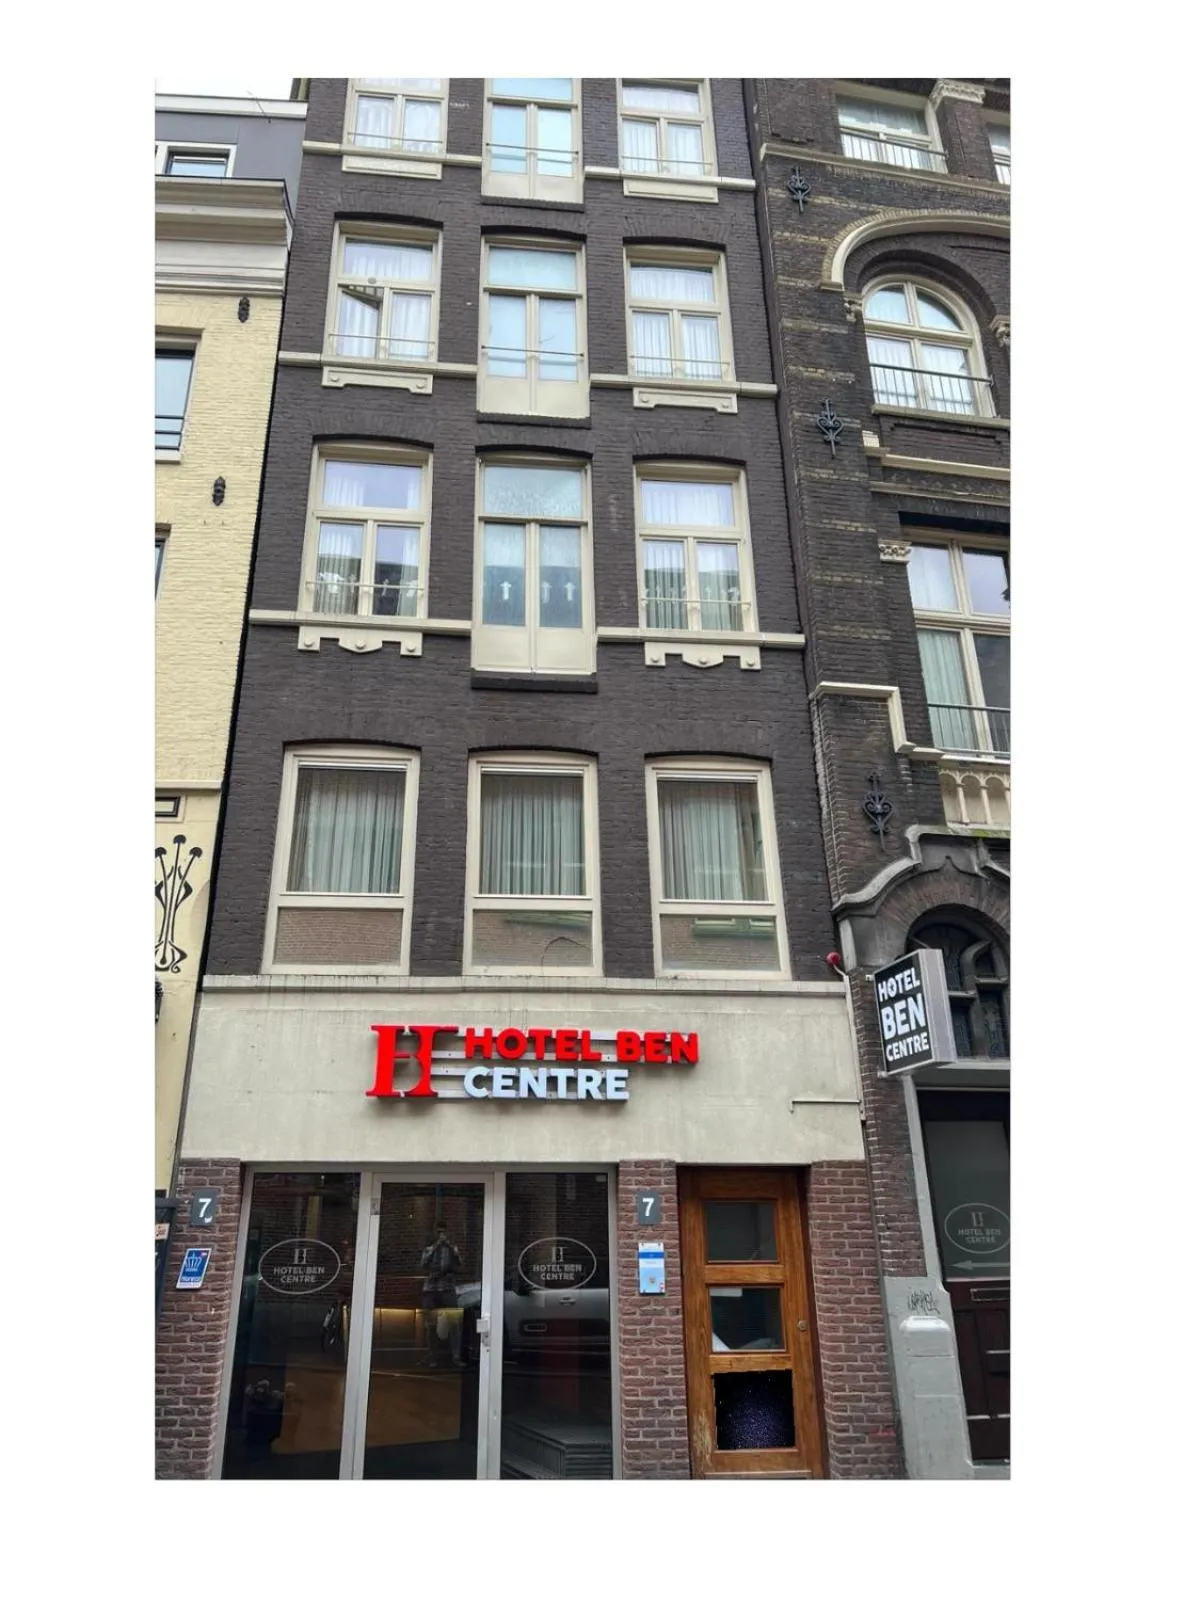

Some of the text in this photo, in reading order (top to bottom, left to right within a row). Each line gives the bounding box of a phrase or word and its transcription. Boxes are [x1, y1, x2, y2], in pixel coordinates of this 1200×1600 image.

[877, 966, 921, 1003] HOTEL
[880, 992, 927, 1041] BEN
[464, 1026, 700, 1066] HOTEL BEN
[885, 1032, 930, 1062] CENTRE
[463, 1065, 630, 1101] CENTRE
[198, 1197, 212, 1218] 7
[642, 1197, 655, 1217] 7
[273, 1266, 326, 1276] HOTEL BEN
[532, 1264, 560, 1272] HOTEL
[540, 1272, 575, 1281] CENTRE
[280, 1275, 317, 1283] CENTRE
